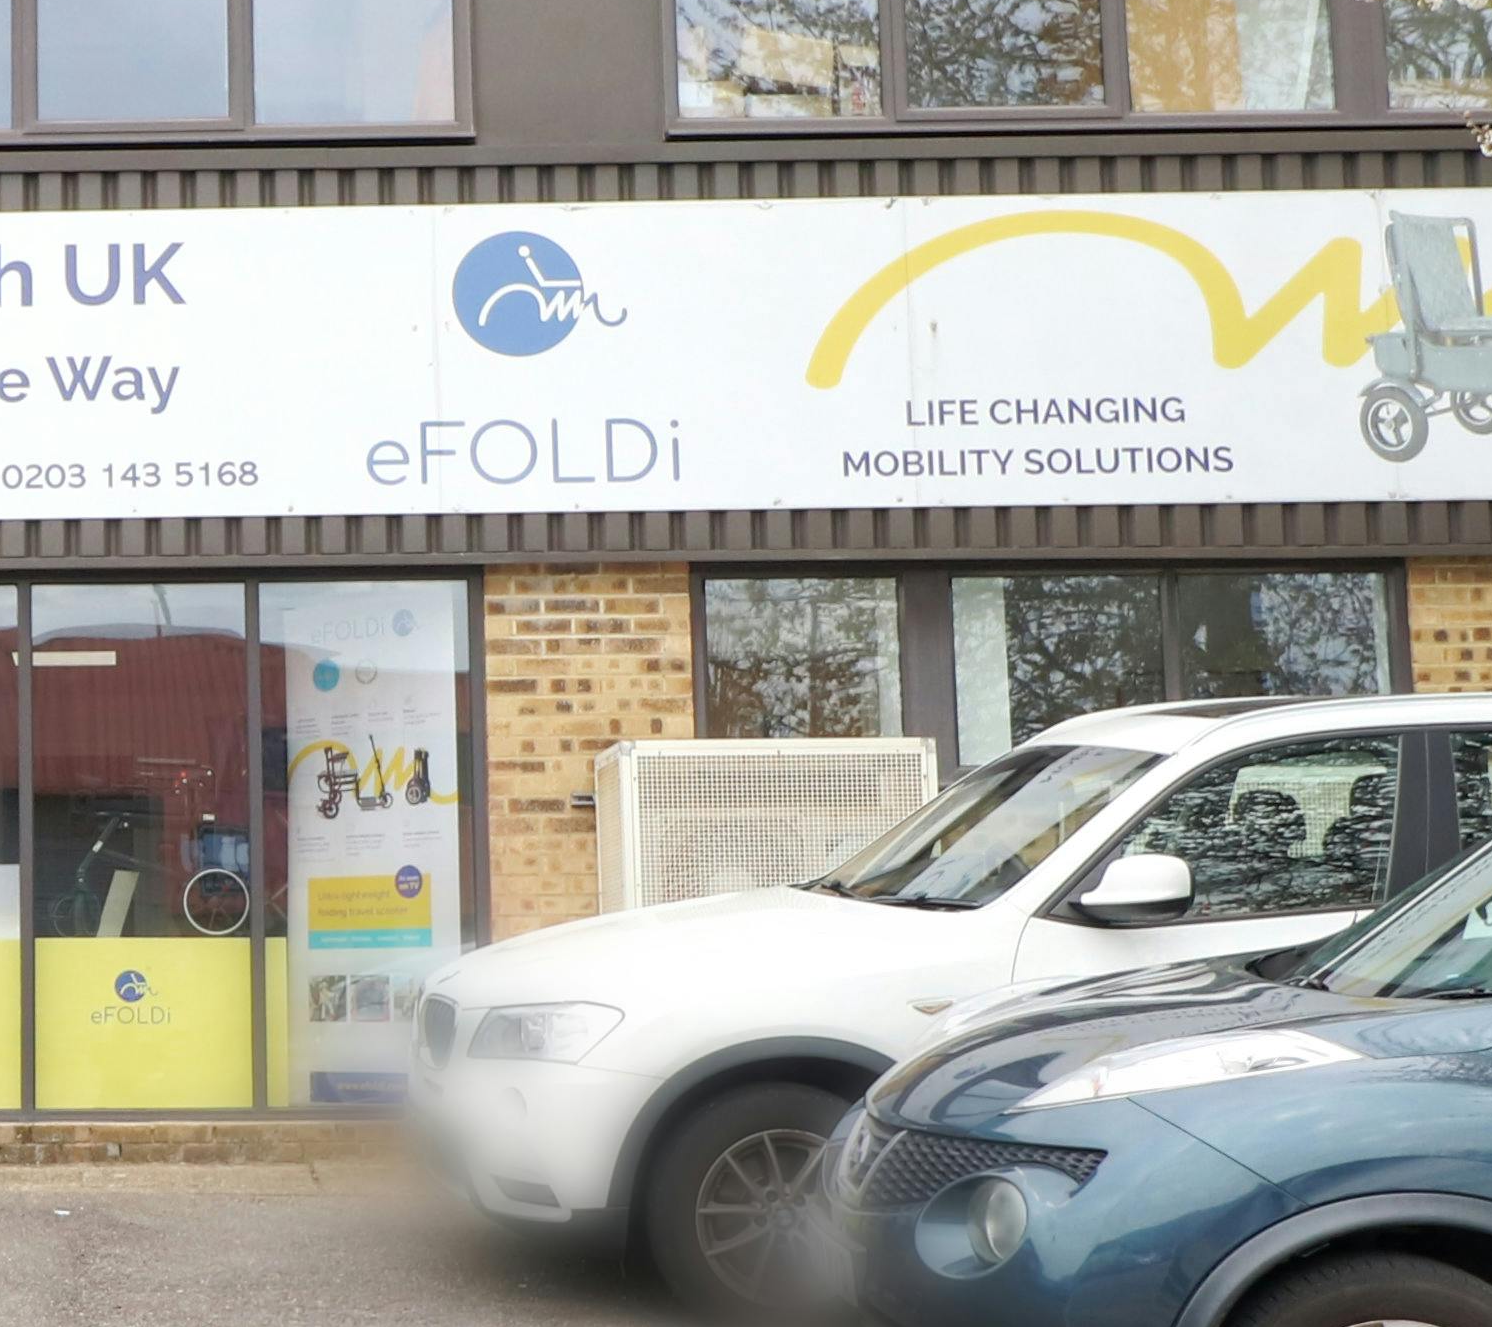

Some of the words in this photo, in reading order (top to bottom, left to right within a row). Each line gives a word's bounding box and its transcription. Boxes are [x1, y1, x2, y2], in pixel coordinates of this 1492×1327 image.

[64, 241, 187, 307] UK
[45, 354, 181, 415] Way
[905, 398, 980, 427] LIFE
[988, 395, 1186, 427] CHANGING
[366, 417, 681, 486] eFOLDi
[842, 448, 1015, 478] MOBILITY
[1024, 445, 1234, 476] SOLUTIONS
[1, 463, 87, 490] 0203
[102, 461, 162, 489] 143
[175, 460, 259, 488] 5168
[90, 1006, 171, 1025] eFOLDi
